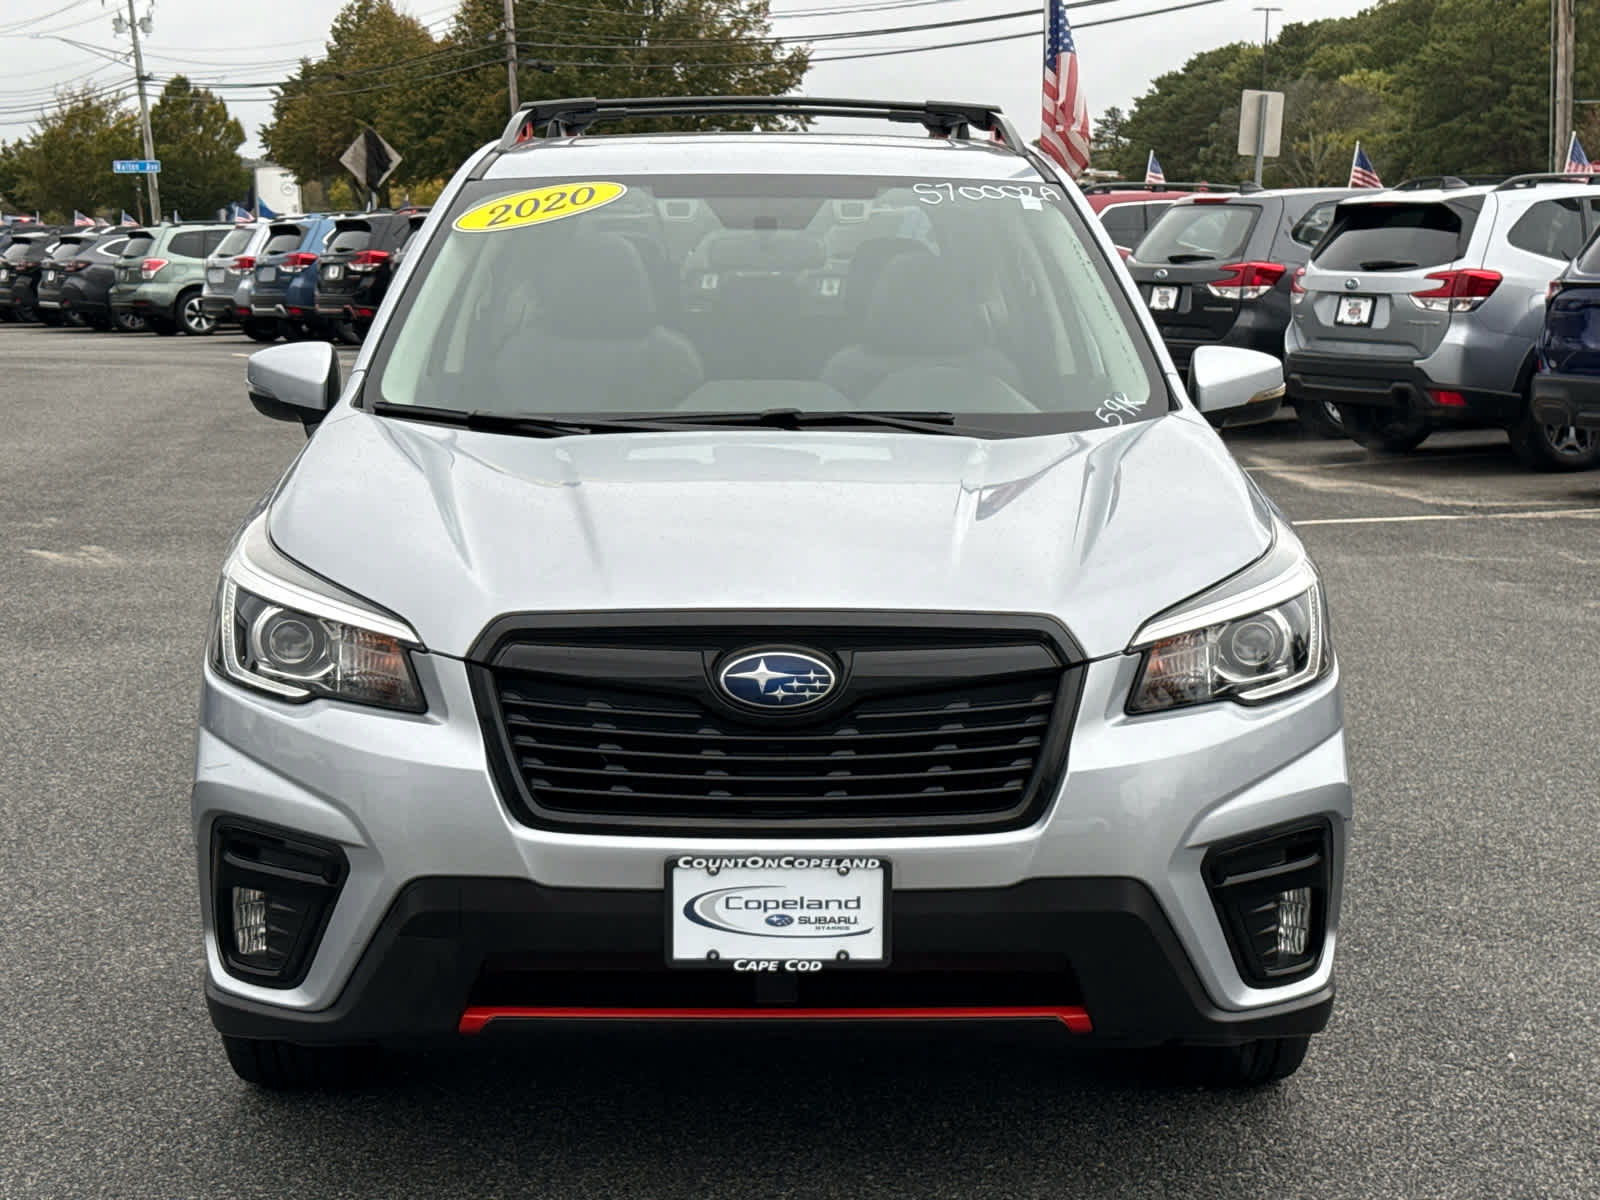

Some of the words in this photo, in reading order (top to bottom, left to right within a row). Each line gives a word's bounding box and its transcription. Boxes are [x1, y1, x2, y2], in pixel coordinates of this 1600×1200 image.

[486, 186, 596, 227] 2020
[724, 896, 861, 913] Copeland
[798, 915, 858, 925] SUBARU
[733, 959, 779, 971] CAPE
[784, 959, 823, 971] COD
